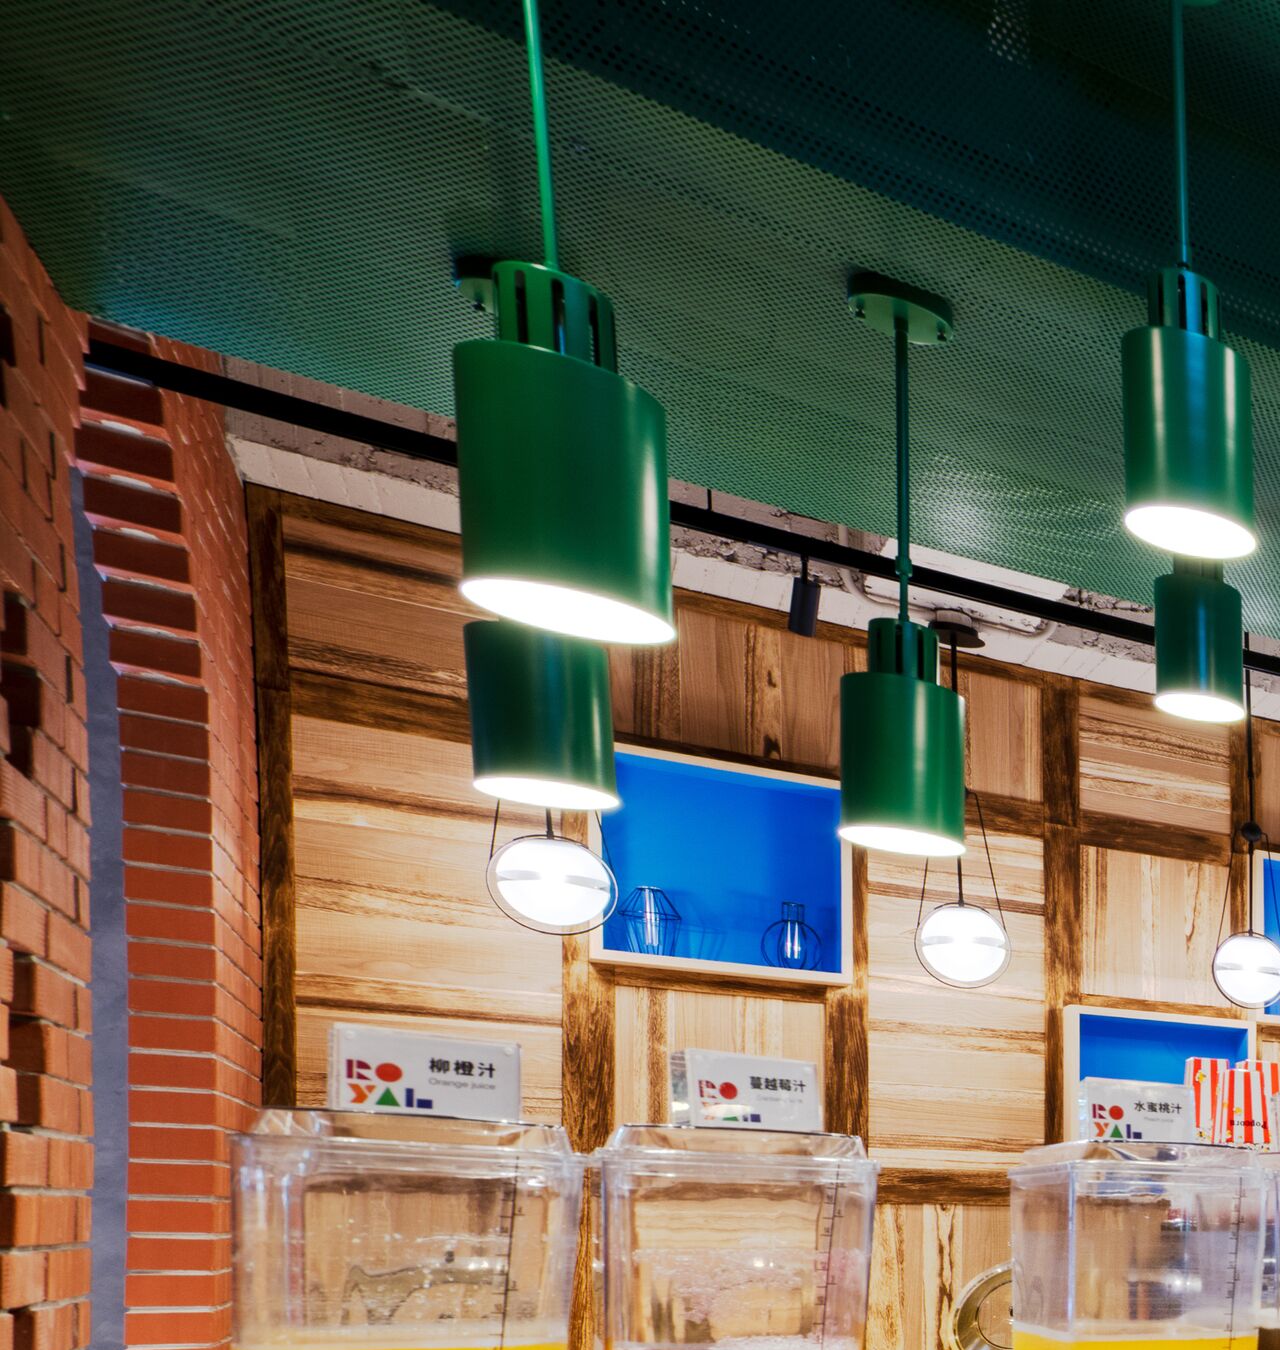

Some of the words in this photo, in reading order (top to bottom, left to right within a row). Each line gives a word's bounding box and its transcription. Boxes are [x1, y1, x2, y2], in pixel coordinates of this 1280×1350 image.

[429, 1057, 496, 1078] 柳橙汁
[428, 1077, 469, 1090] Orange
[470, 1080, 496, 1091] juice
[1134, 1101, 1183, 1115] 水蜜桃汁
